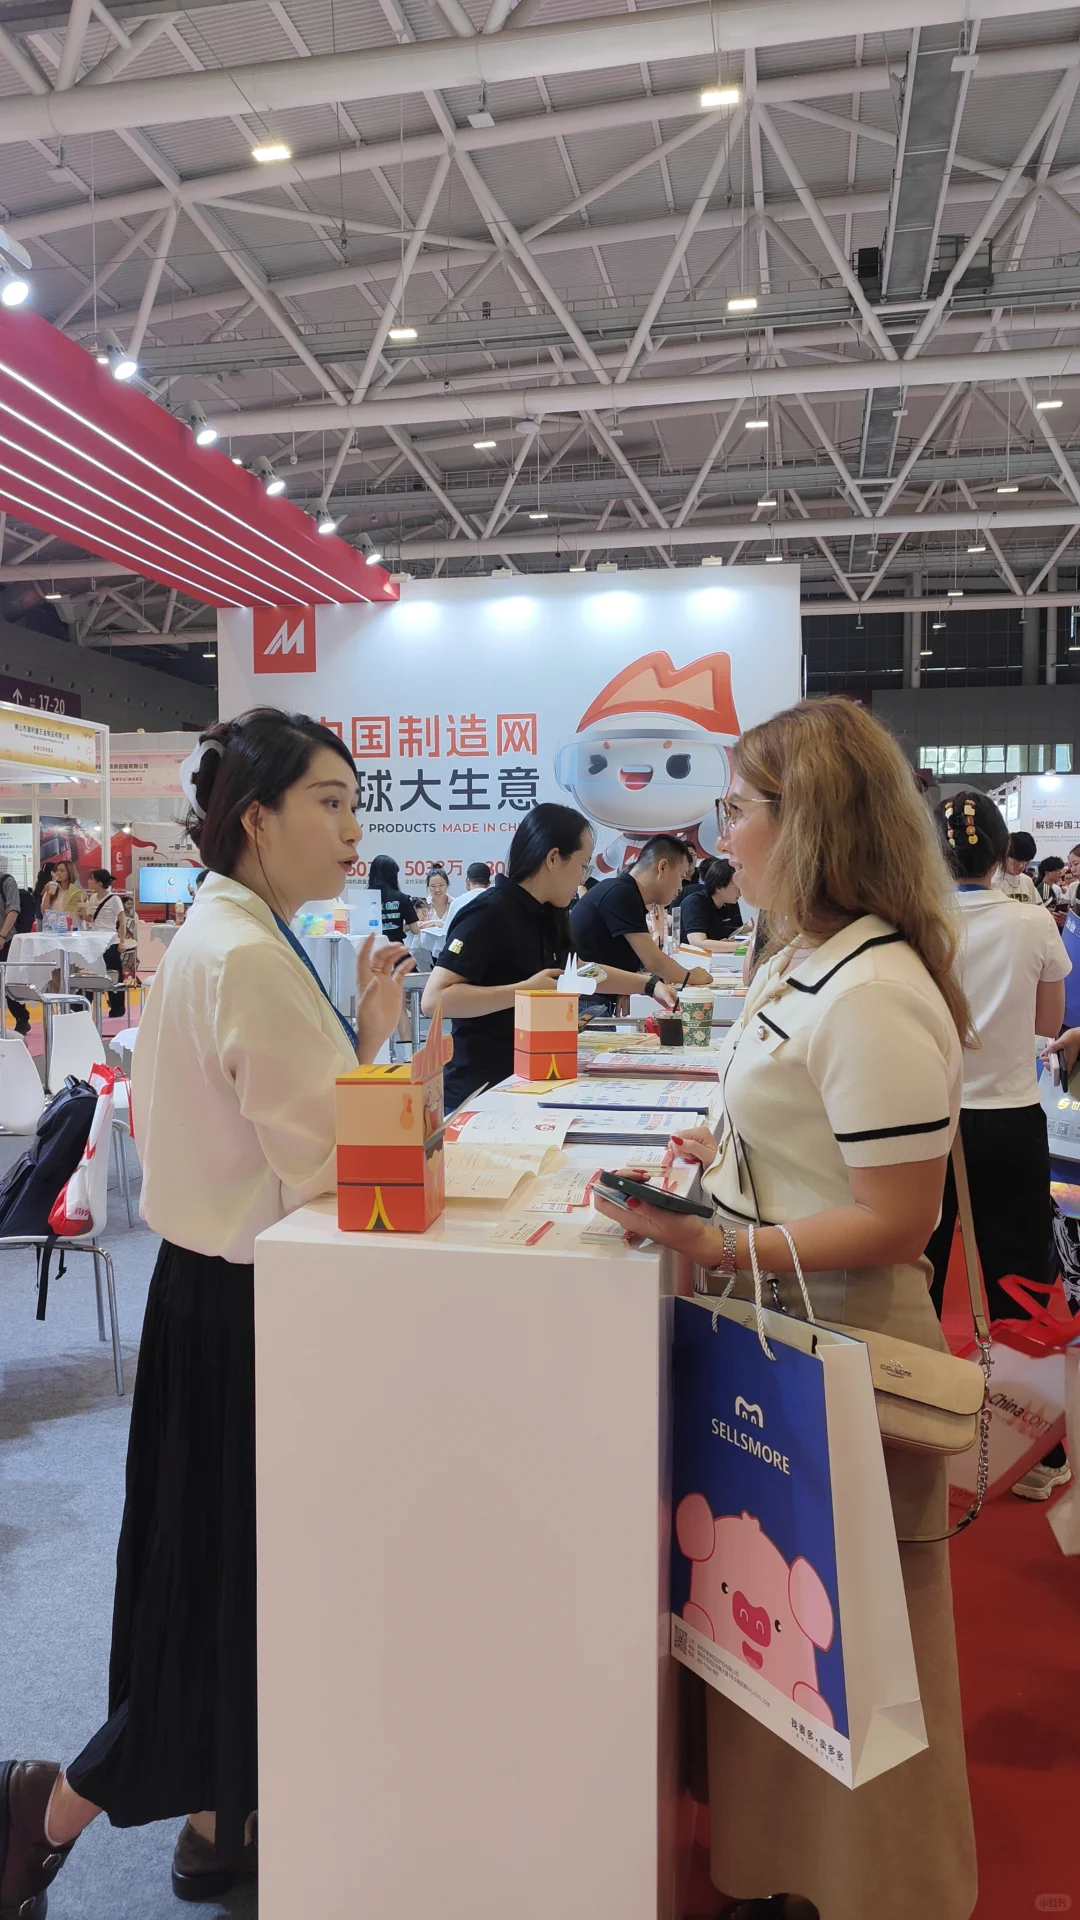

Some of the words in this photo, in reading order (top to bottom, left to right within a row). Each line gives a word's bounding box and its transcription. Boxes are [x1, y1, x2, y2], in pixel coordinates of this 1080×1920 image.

[39, 694, 65, 715] 17-20
[369, 823, 436, 833] PRODUCTS
[442, 823, 479, 833] MADE
[483, 822, 496, 832] IN
[711, 1417, 790, 1475] SELLSMORE
